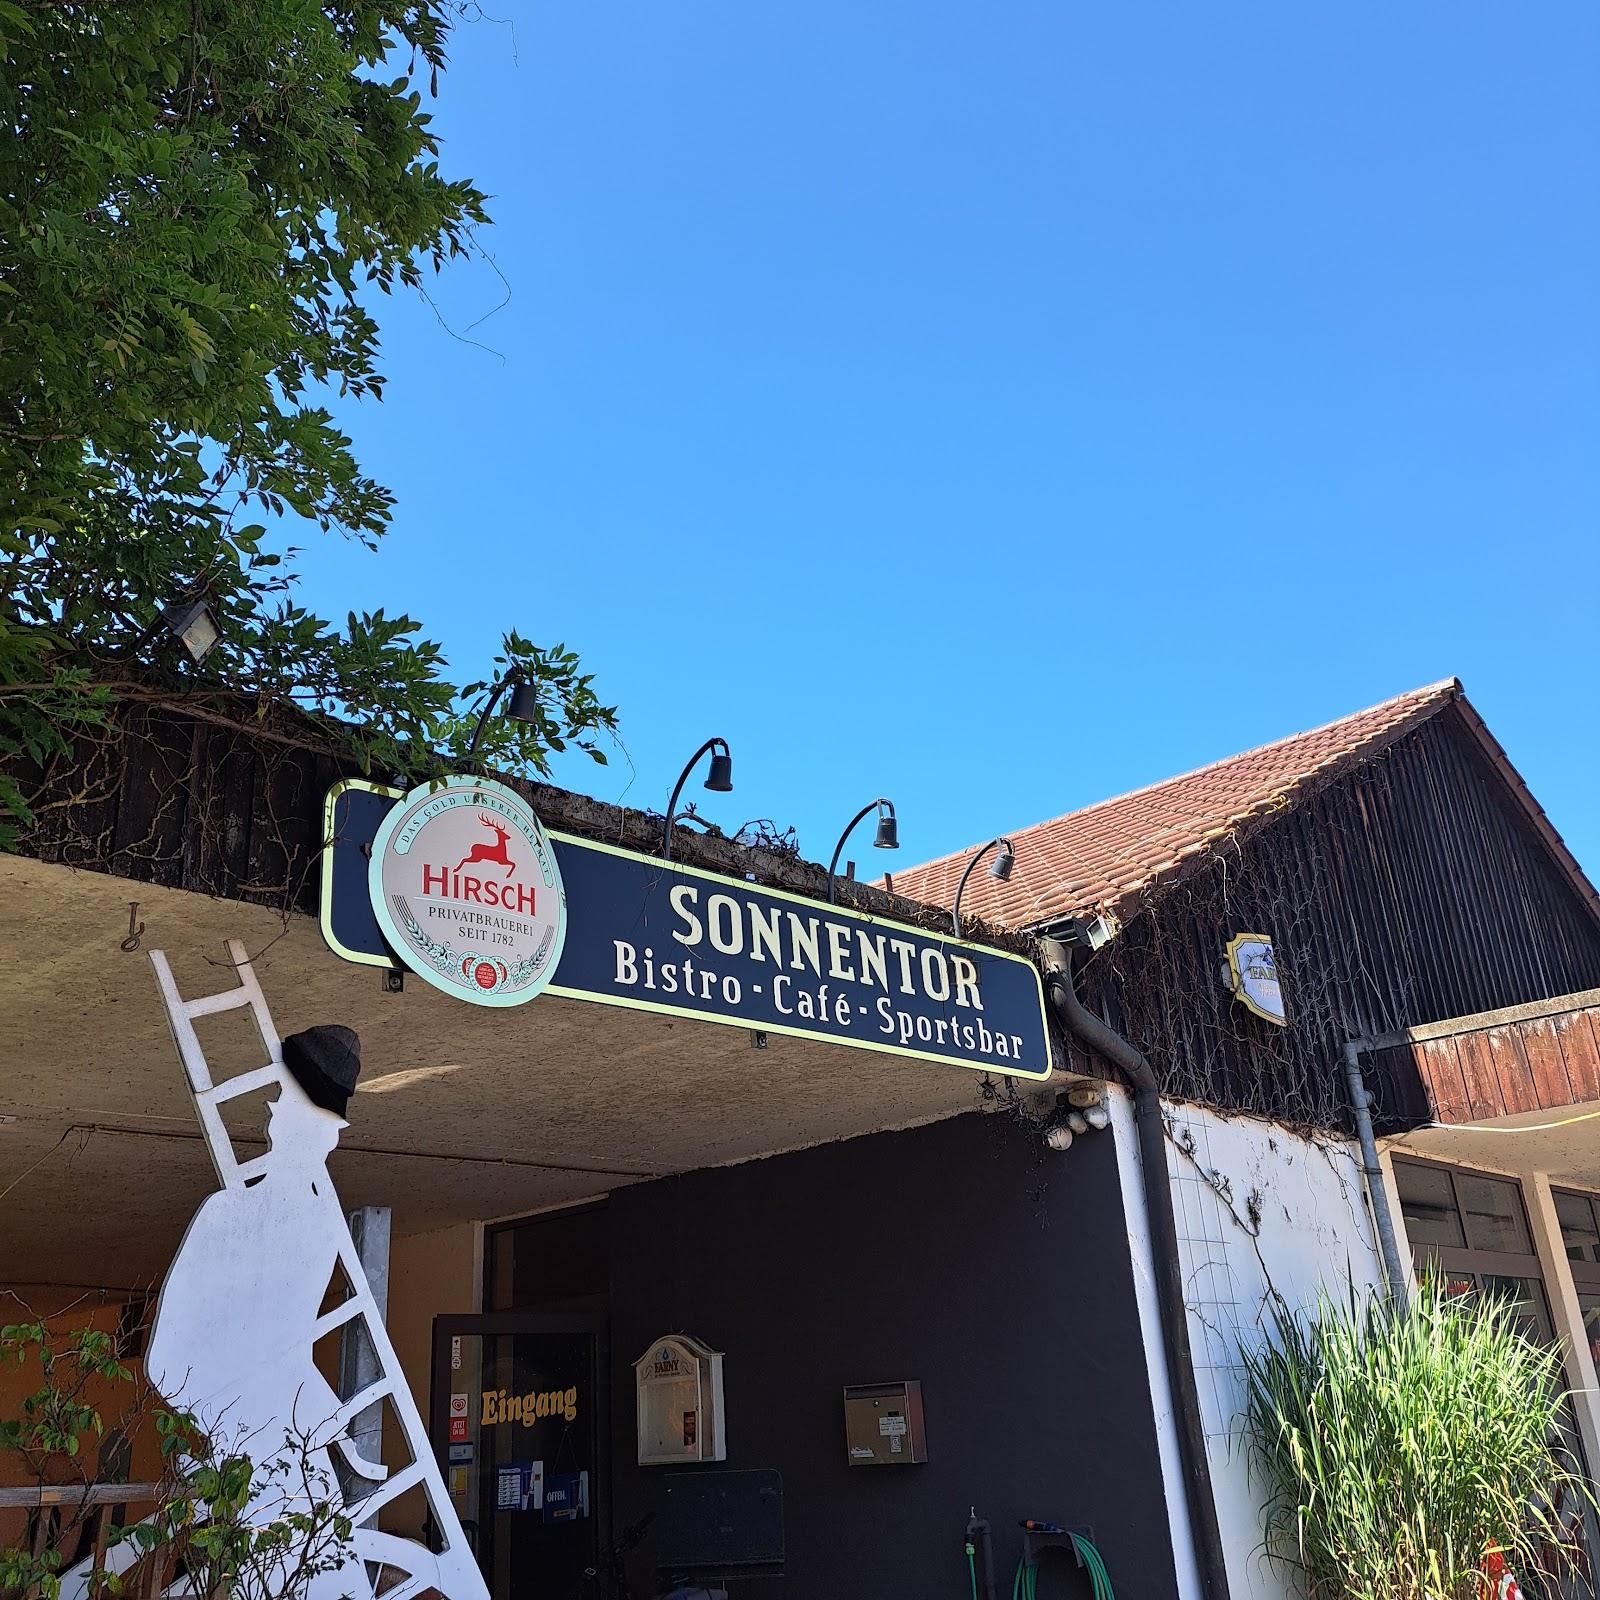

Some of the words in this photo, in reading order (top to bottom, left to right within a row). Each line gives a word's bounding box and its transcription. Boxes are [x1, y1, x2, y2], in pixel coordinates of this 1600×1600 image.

[402, 820, 420, 843] DAS
[424, 797, 456, 817] GOLD
[422, 863, 536, 917] HIRSCH
[428, 906, 534, 937] PRIVATBRAUEREI
[458, 926, 488, 941] SEIT
[492, 932, 514, 947] 1782
[669, 884, 985, 1010] SONNENTOR
[612, 939, 742, 1005] Bistro
[773, 974, 851, 1026] Café
[876, 997, 1024, 1060] Sportsbar
[481, 1385, 577, 1428] Eingang
